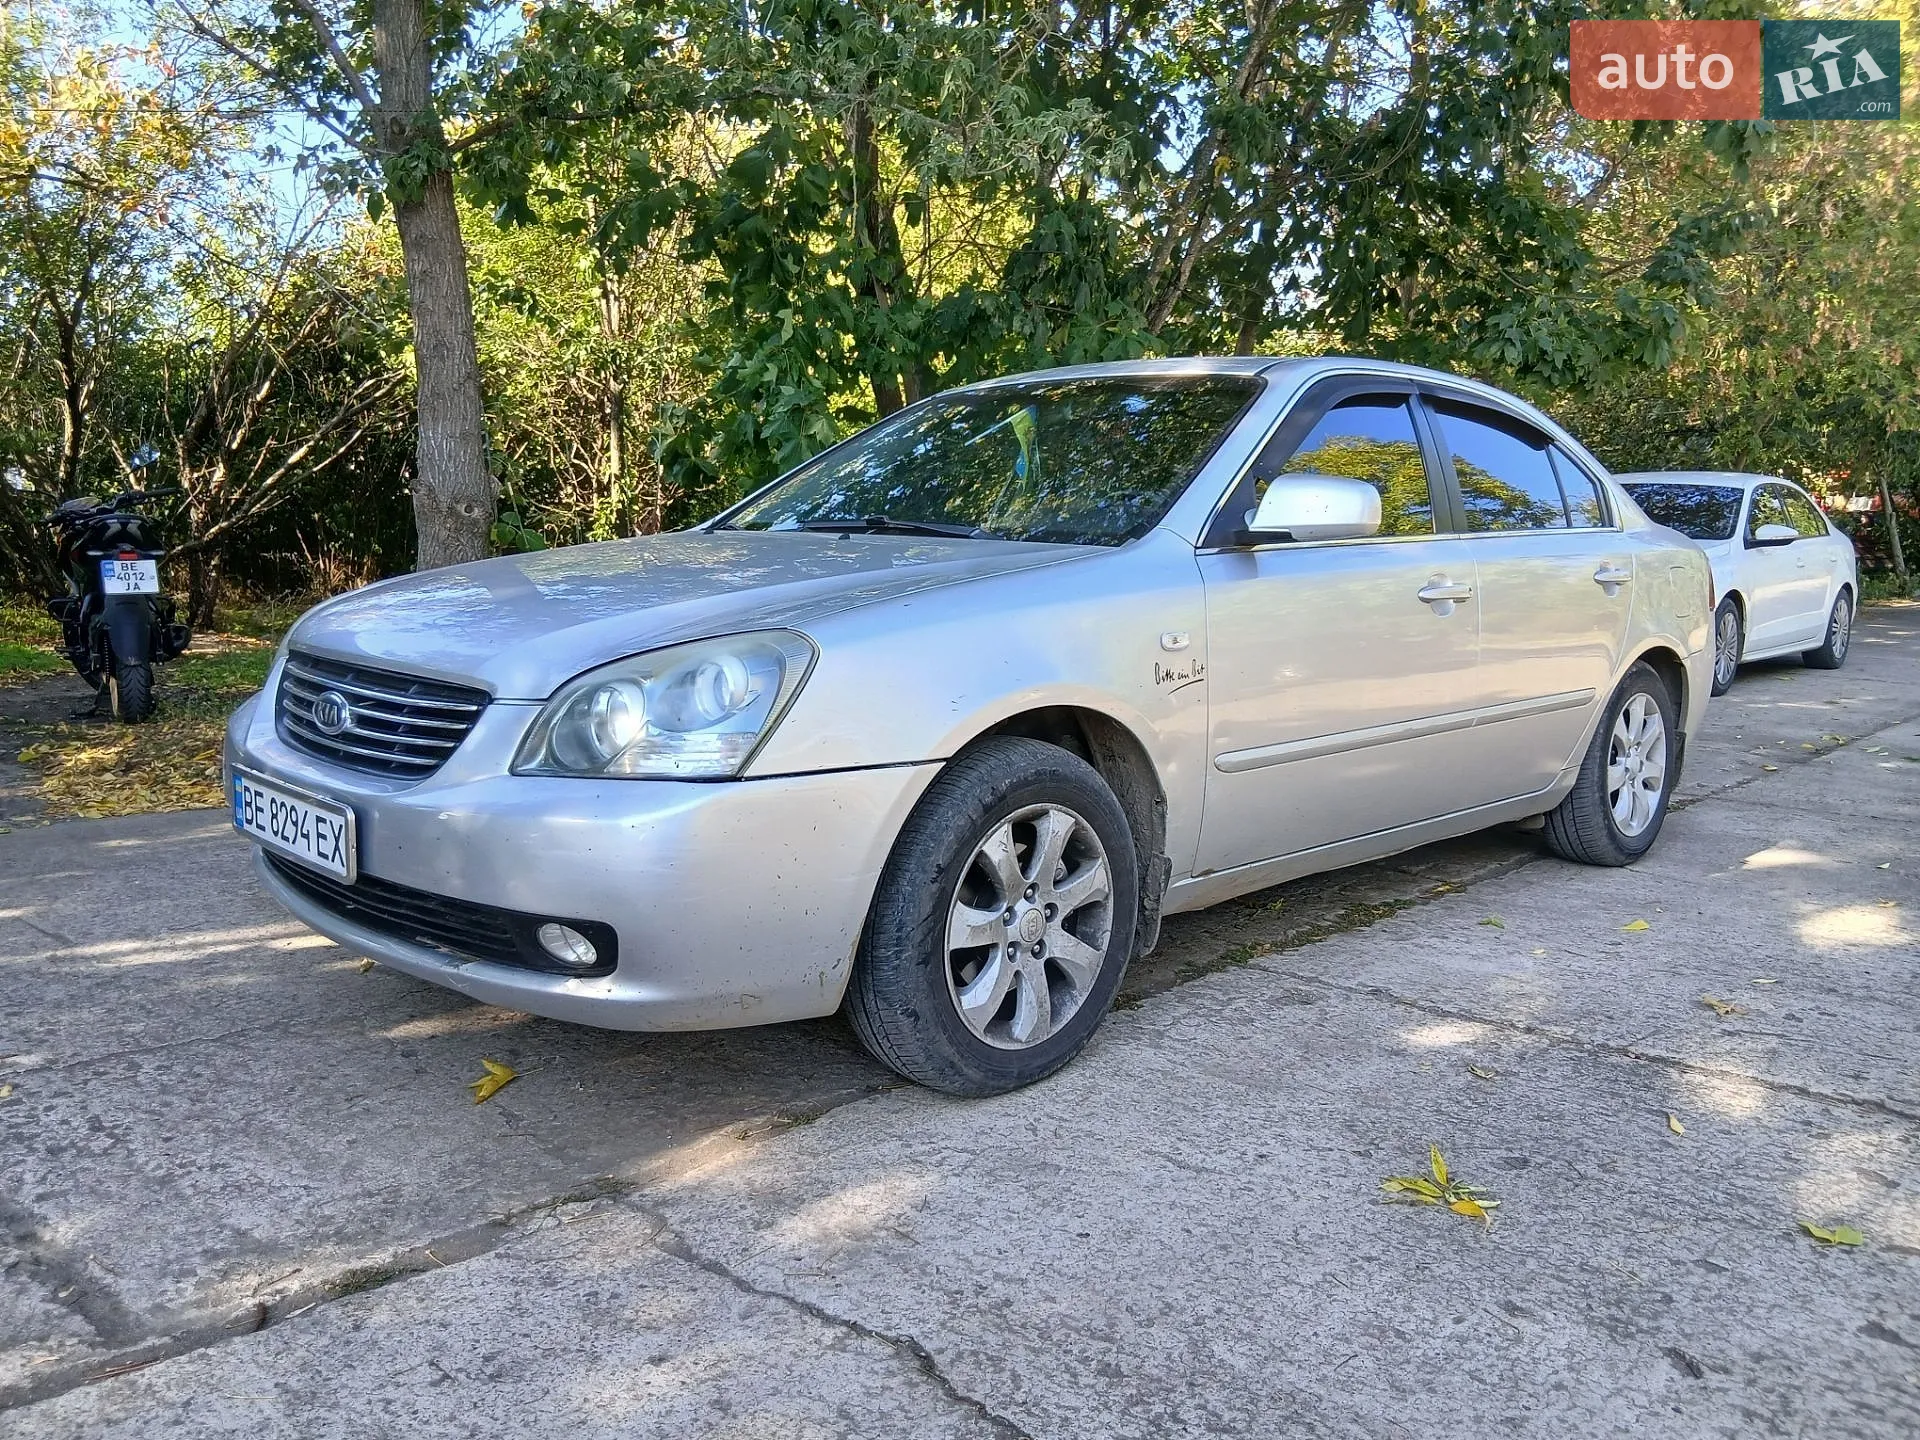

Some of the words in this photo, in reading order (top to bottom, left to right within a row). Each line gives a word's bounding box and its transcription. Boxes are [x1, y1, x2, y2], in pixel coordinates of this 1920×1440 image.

[120, 562, 138, 571] BE
[116, 572, 146, 582] 4012
[125, 582, 141, 591] JA
[243, 784, 266, 832] BE
[269, 796, 311, 852] 8294
[315, 814, 346, 869] EX
